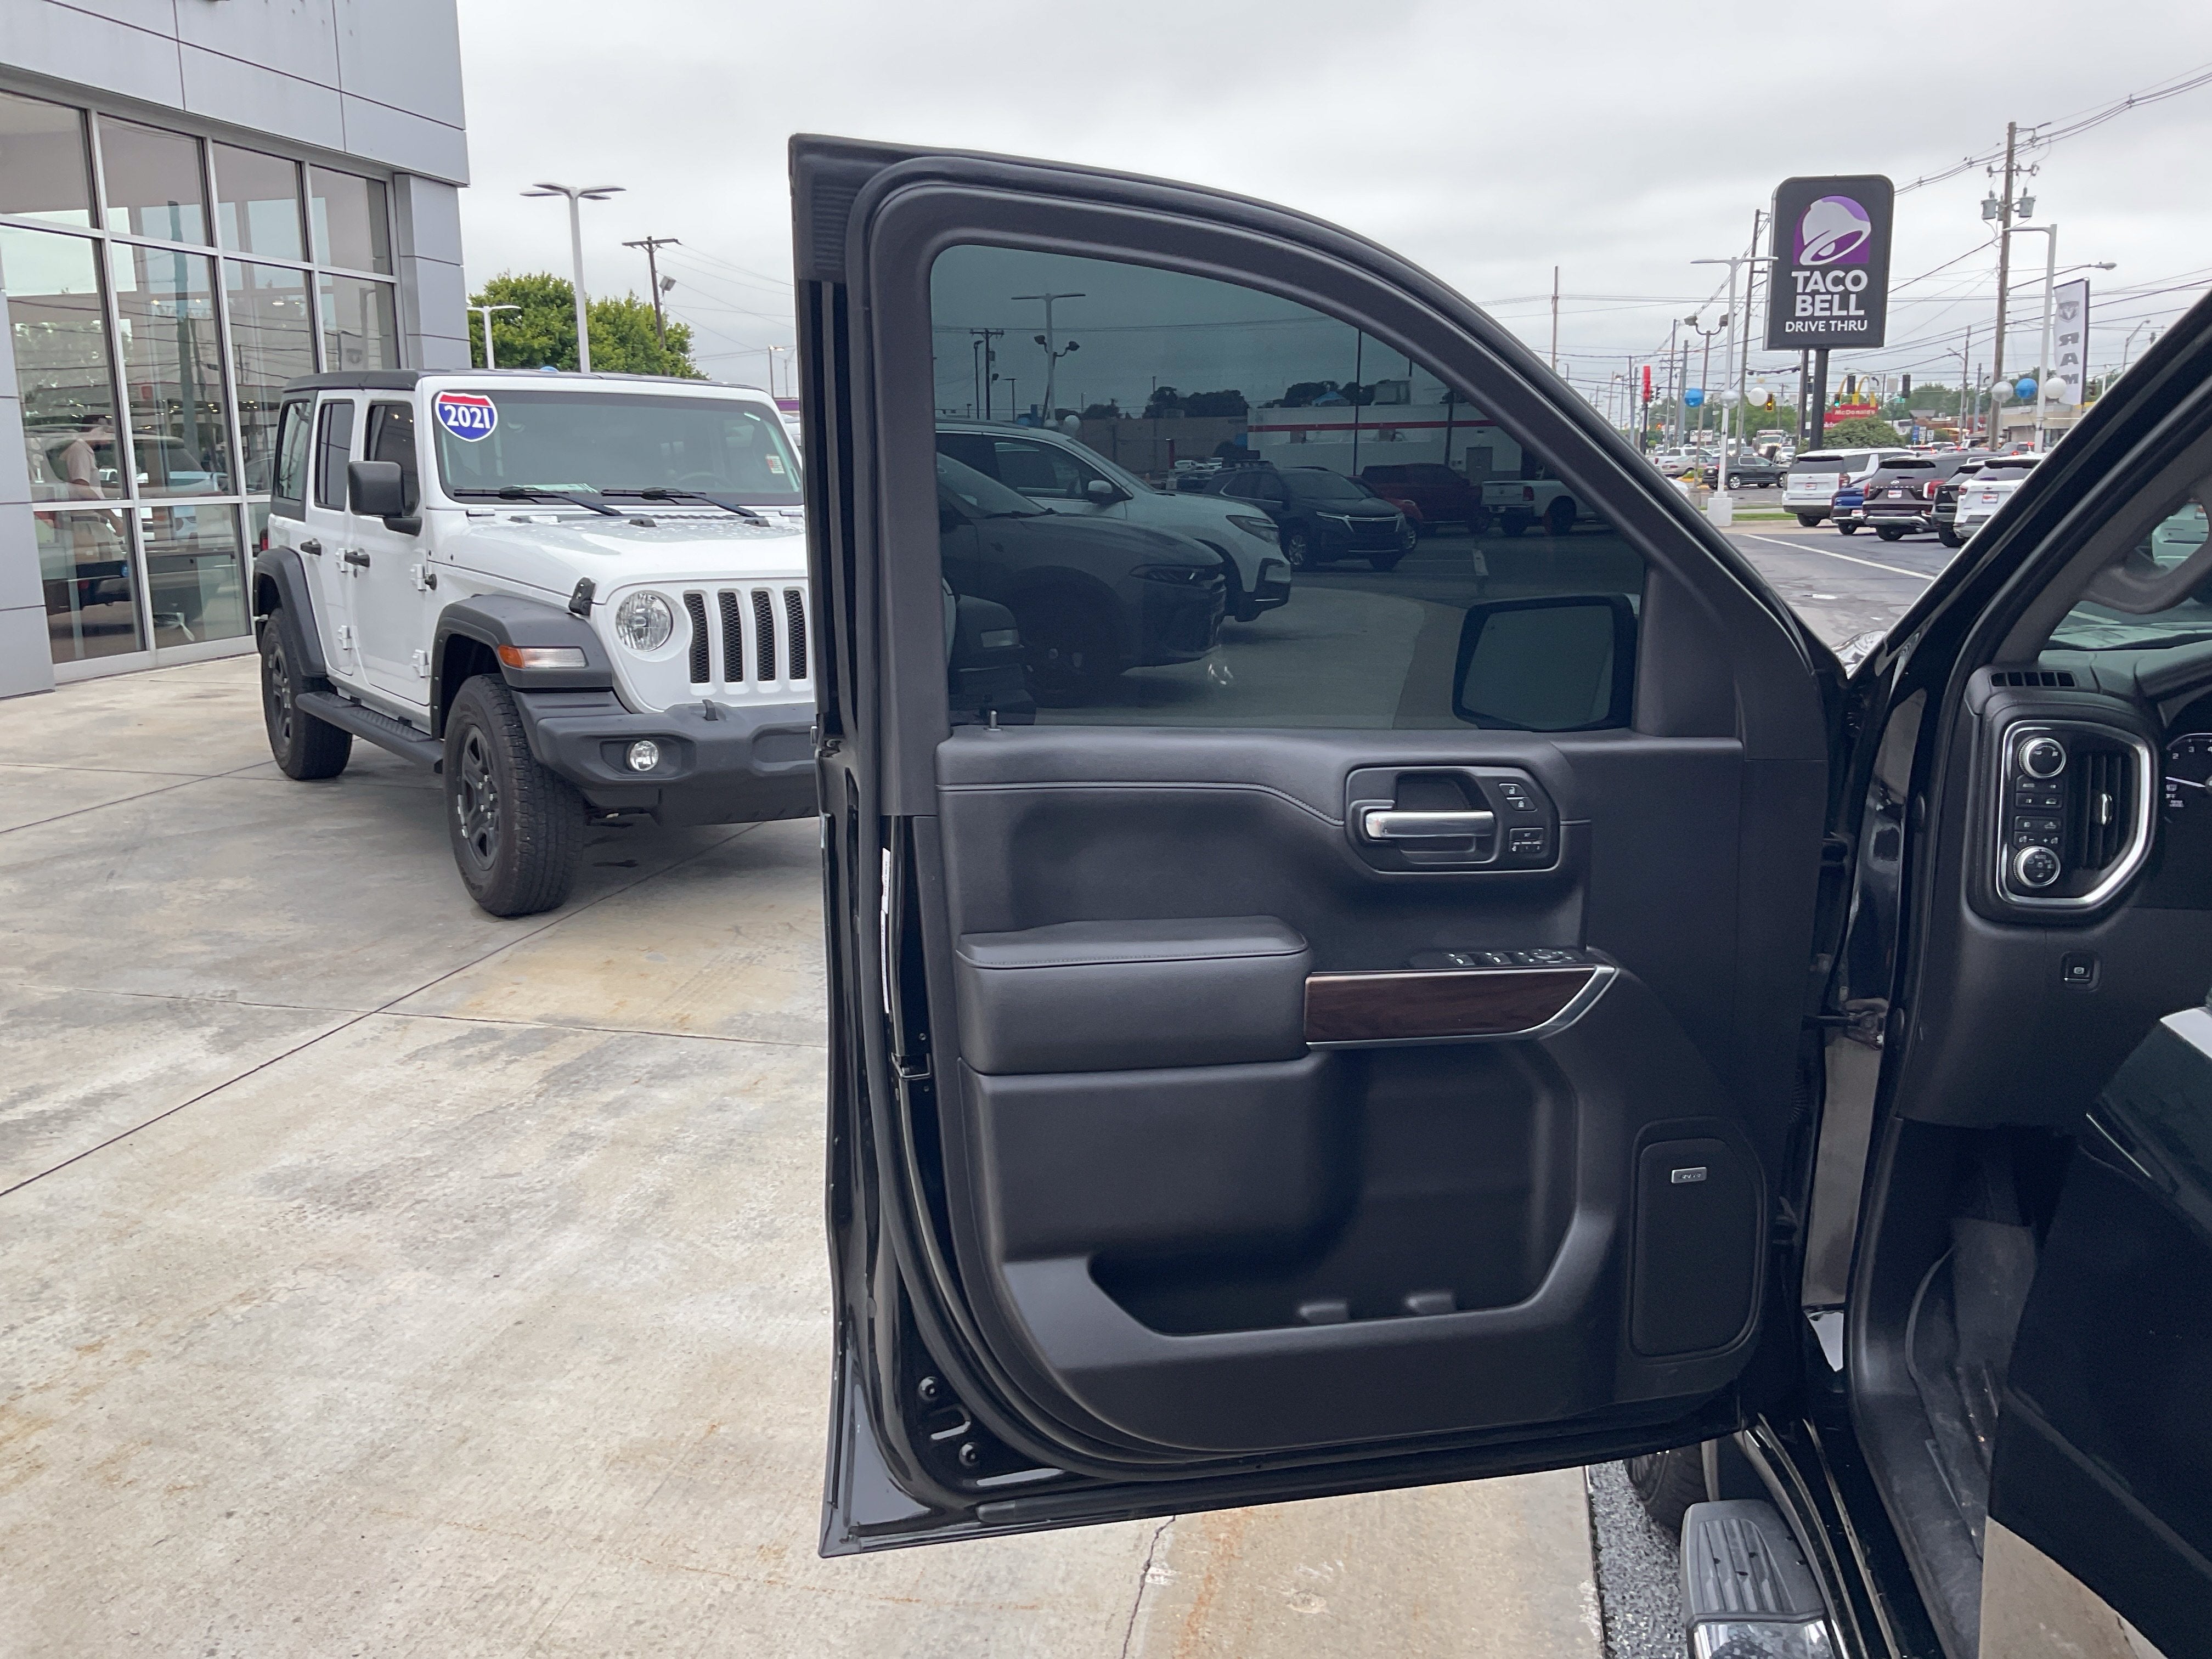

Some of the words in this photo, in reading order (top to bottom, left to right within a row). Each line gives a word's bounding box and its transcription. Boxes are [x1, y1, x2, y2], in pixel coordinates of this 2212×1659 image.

[1791, 269, 1868, 294] TACO
[1795, 294, 1865, 317] BELL
[1785, 320, 1826, 332] DRIVE
[1829, 320, 1868, 332] THRU
[444, 405, 491, 429] 2021
